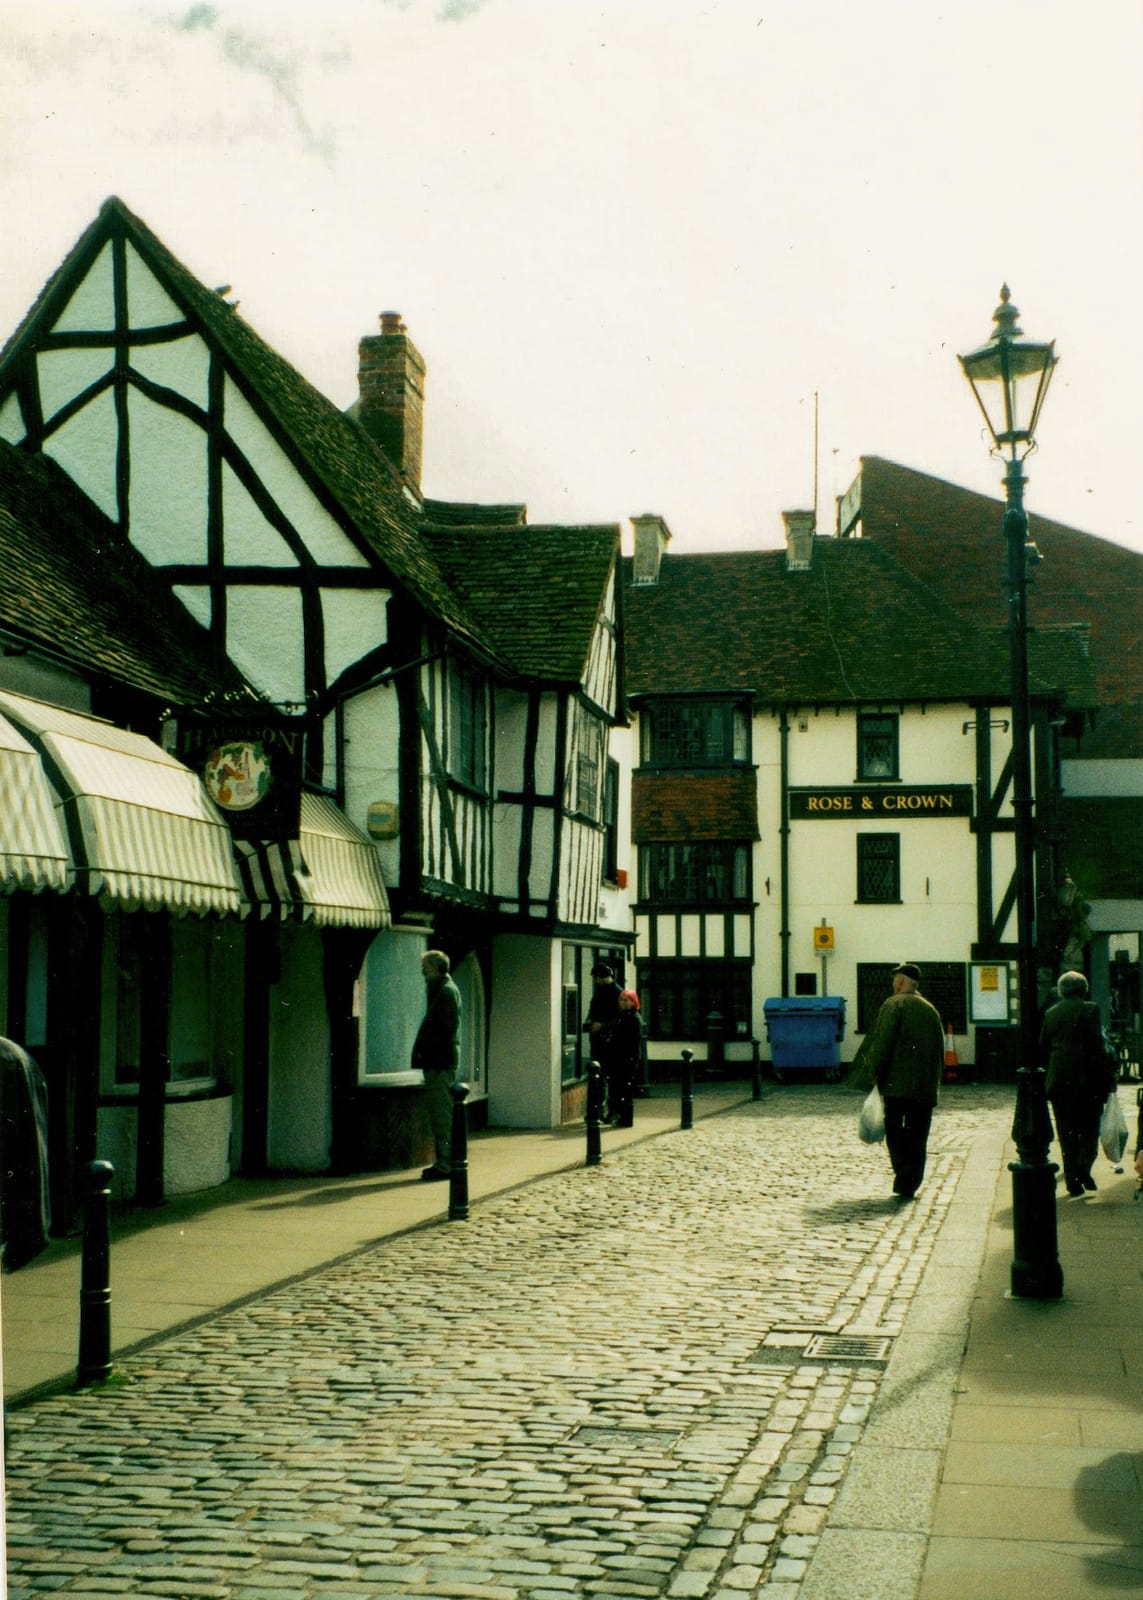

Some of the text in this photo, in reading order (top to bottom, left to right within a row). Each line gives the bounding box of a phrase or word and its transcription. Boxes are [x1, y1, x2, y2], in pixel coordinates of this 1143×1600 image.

[807, 795, 953, 811] ROSE & CROWN
